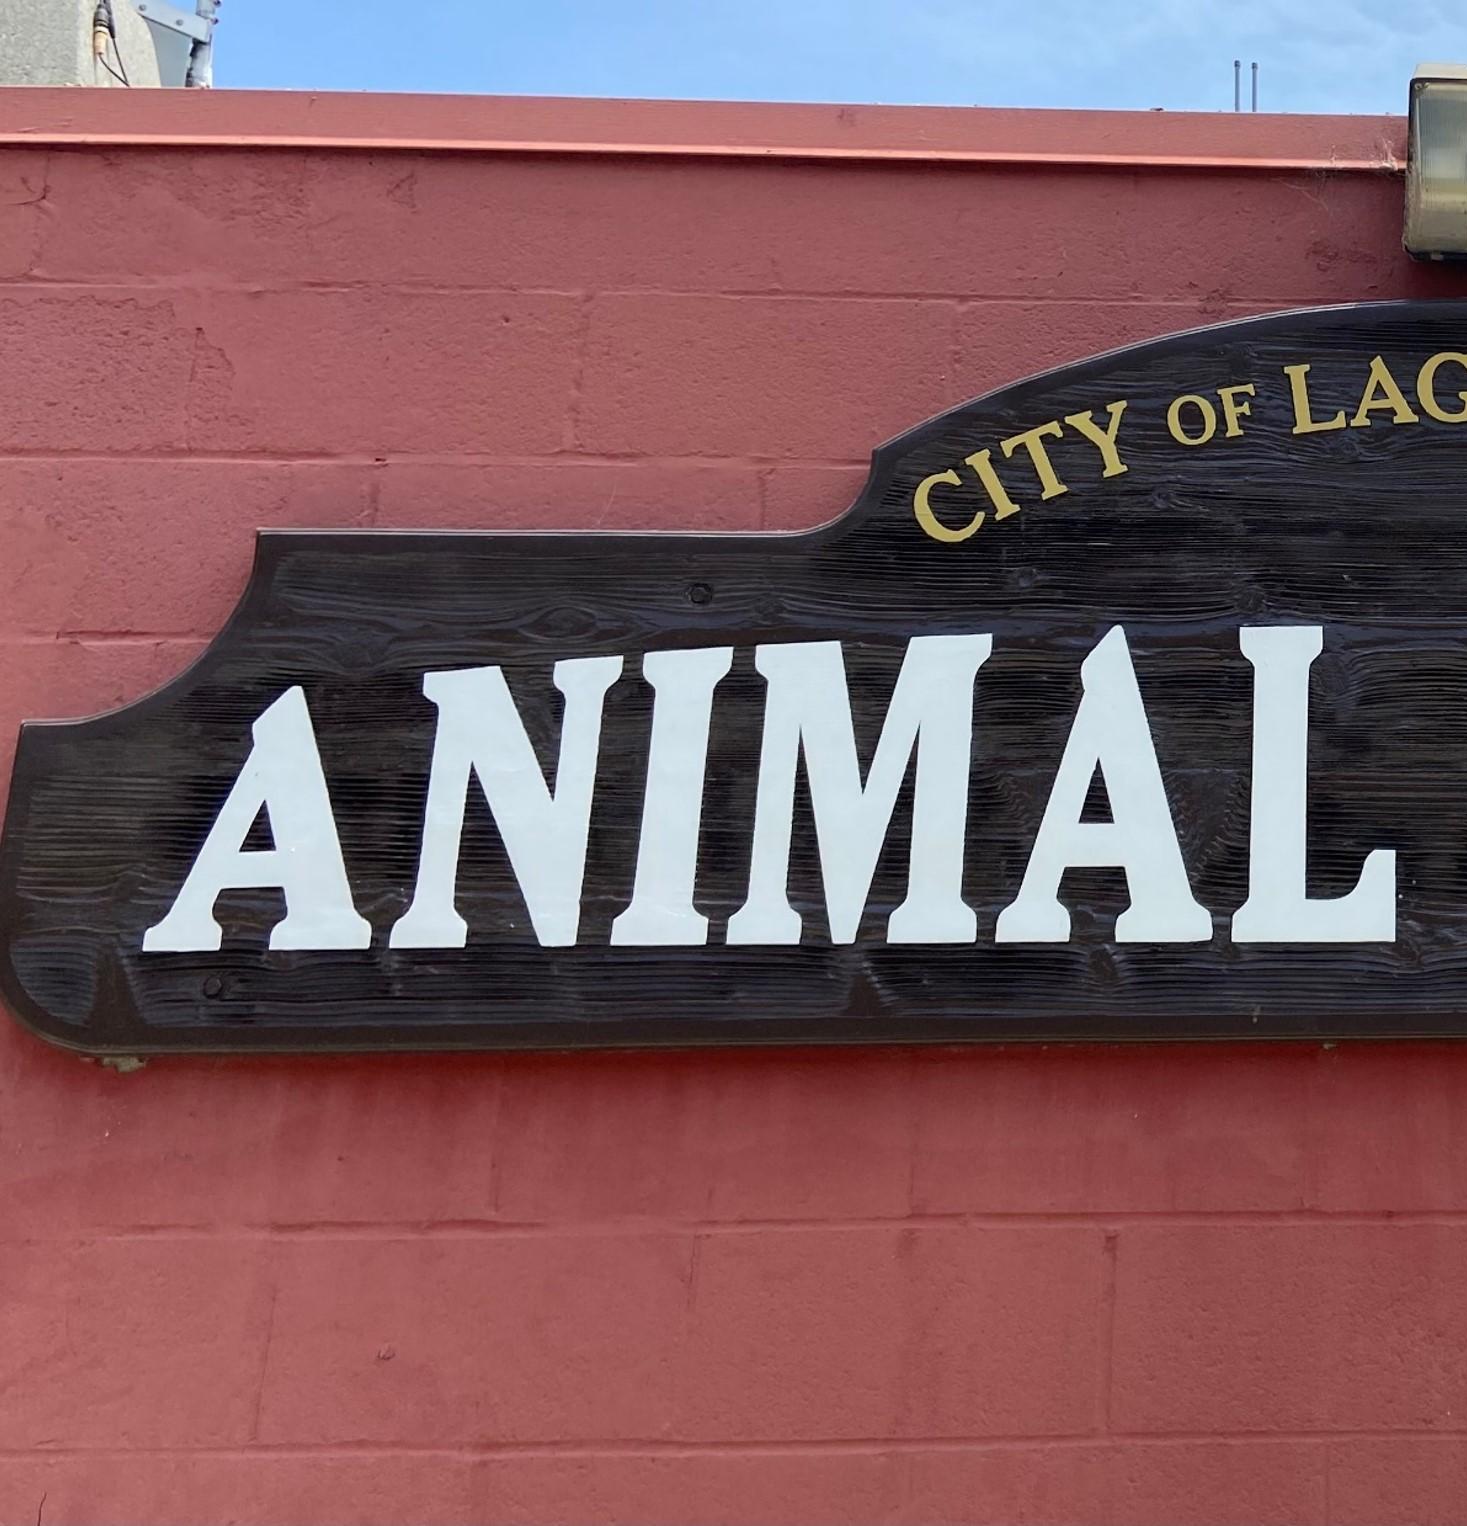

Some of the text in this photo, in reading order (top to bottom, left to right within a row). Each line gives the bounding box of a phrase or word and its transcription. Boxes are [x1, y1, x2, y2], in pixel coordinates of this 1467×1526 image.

[912, 400, 1130, 546] CITY
[1166, 383, 1256, 446] OF
[142, 624, 1397, 954] ANIMAL
